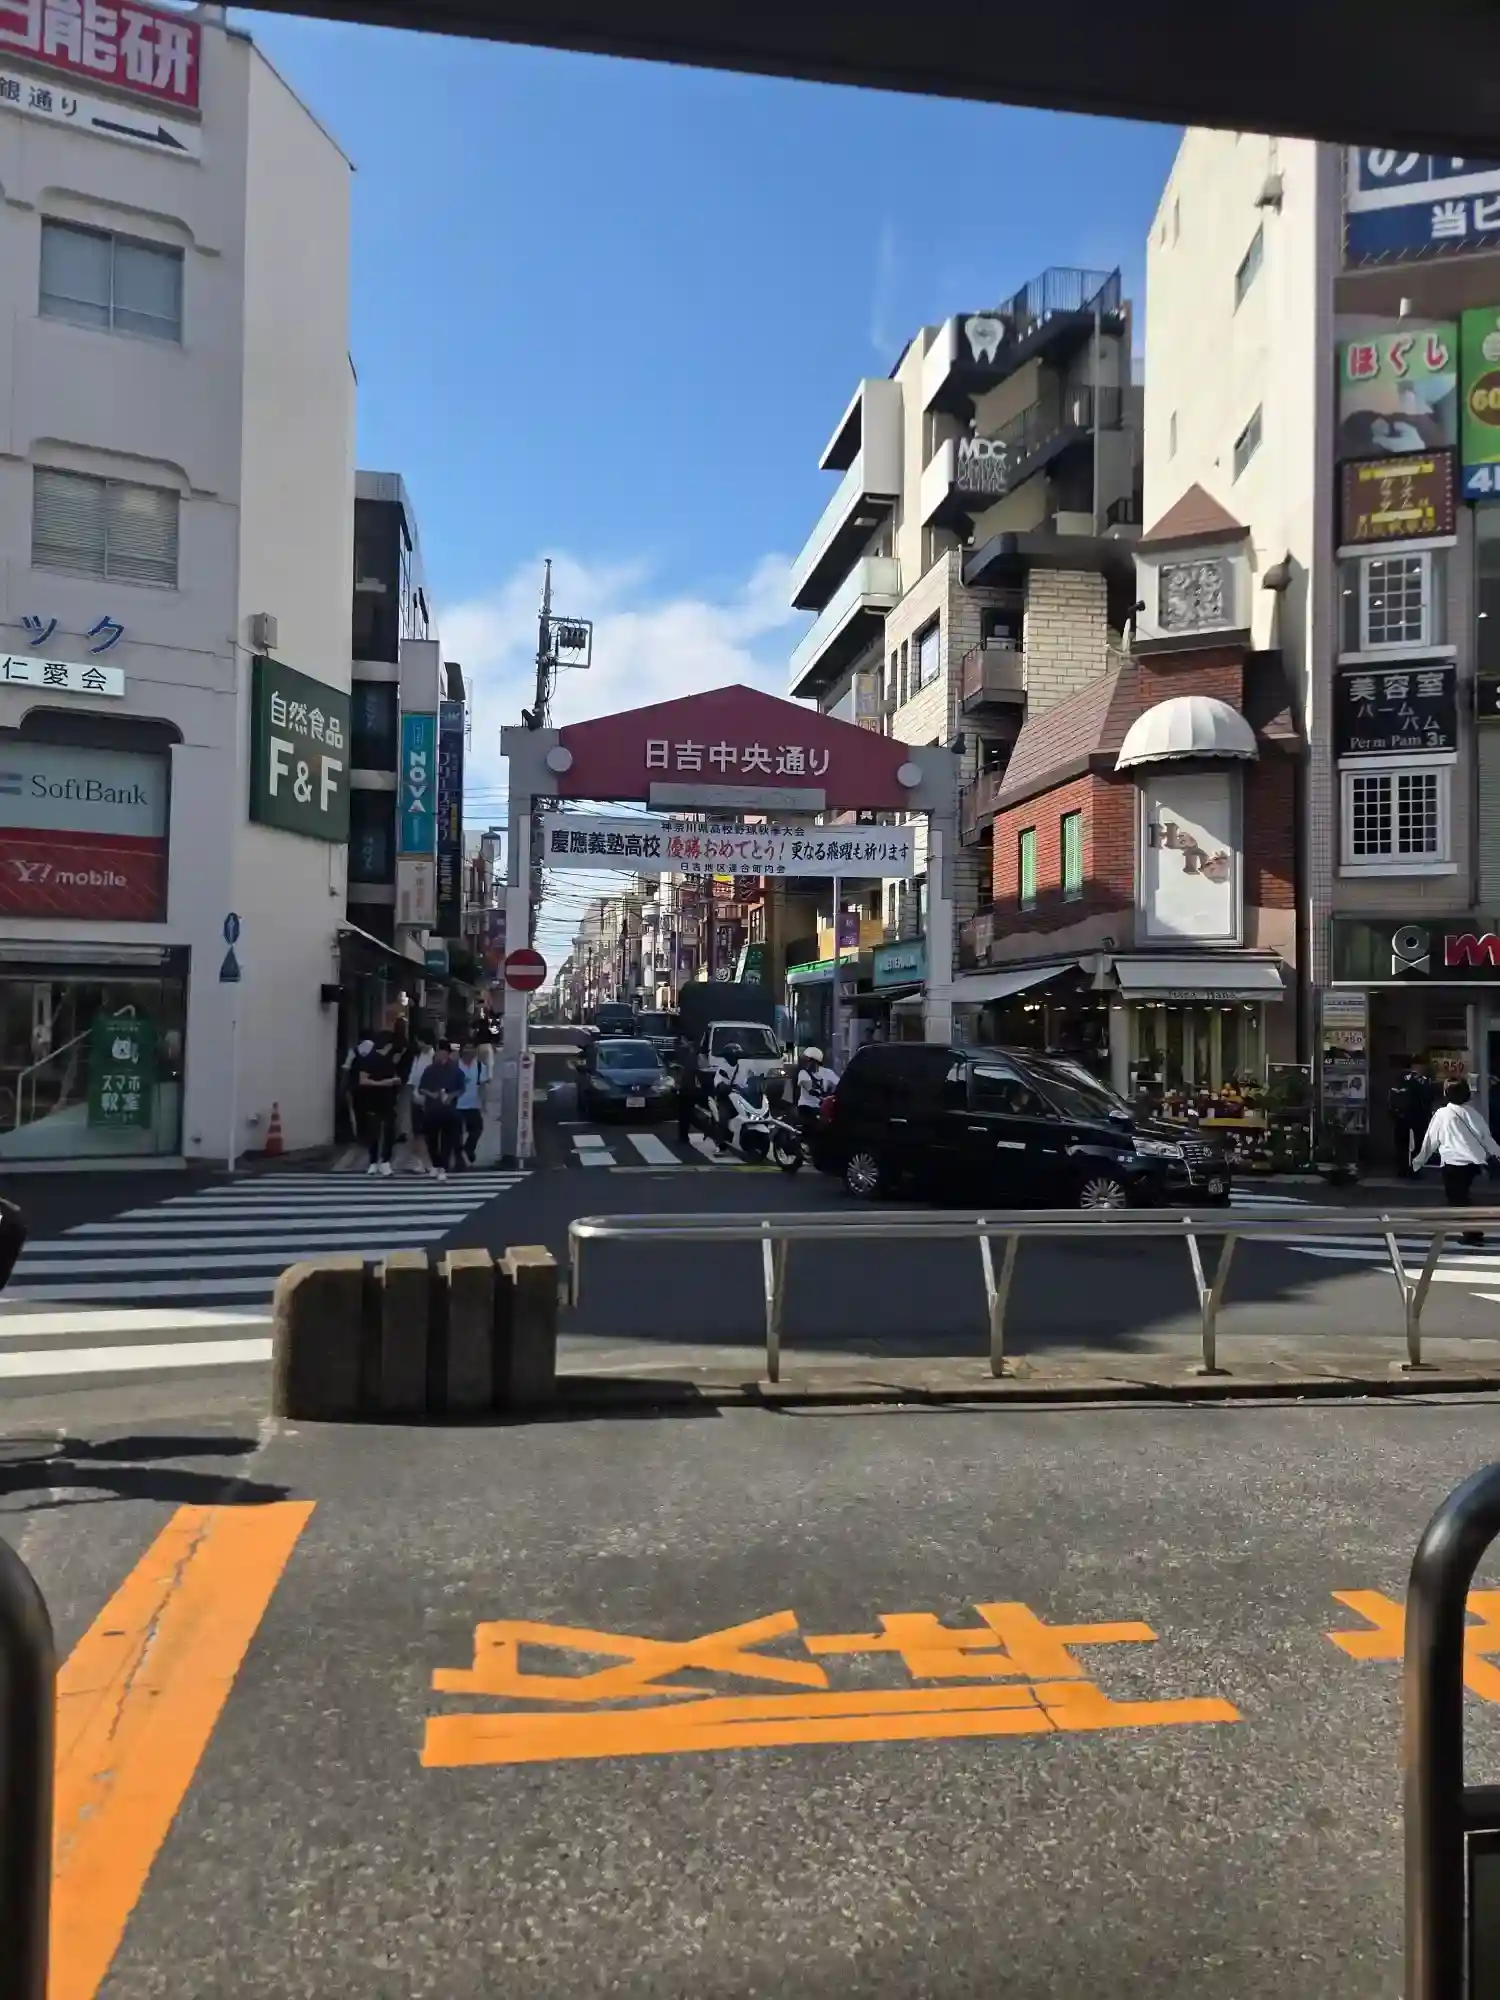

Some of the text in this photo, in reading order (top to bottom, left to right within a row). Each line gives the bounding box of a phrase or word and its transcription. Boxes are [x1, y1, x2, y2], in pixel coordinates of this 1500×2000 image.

[1348, 333, 1448, 379] ほぐし
[958, 436, 1008, 460] MDC
[2, 656, 107, 692] 仁愛会
[1350, 673, 1444, 702] 美容室
[271, 690, 344, 749] 自然食品
[1350, 732, 1447, 749] Perm Pam 3F
[646, 739, 830, 776] 日吉中央通り
[30, 774, 149, 805] SoftBank
[408, 751, 427, 813] NOVA
[551, 829, 661, 858] 慶應義塾高校
[791, 841, 910, 862] 更なる飛躍も祈ります
[680, 862, 786, 874] 日吉地区連合町内会
[102, 1075, 140, 1091] スマホ
